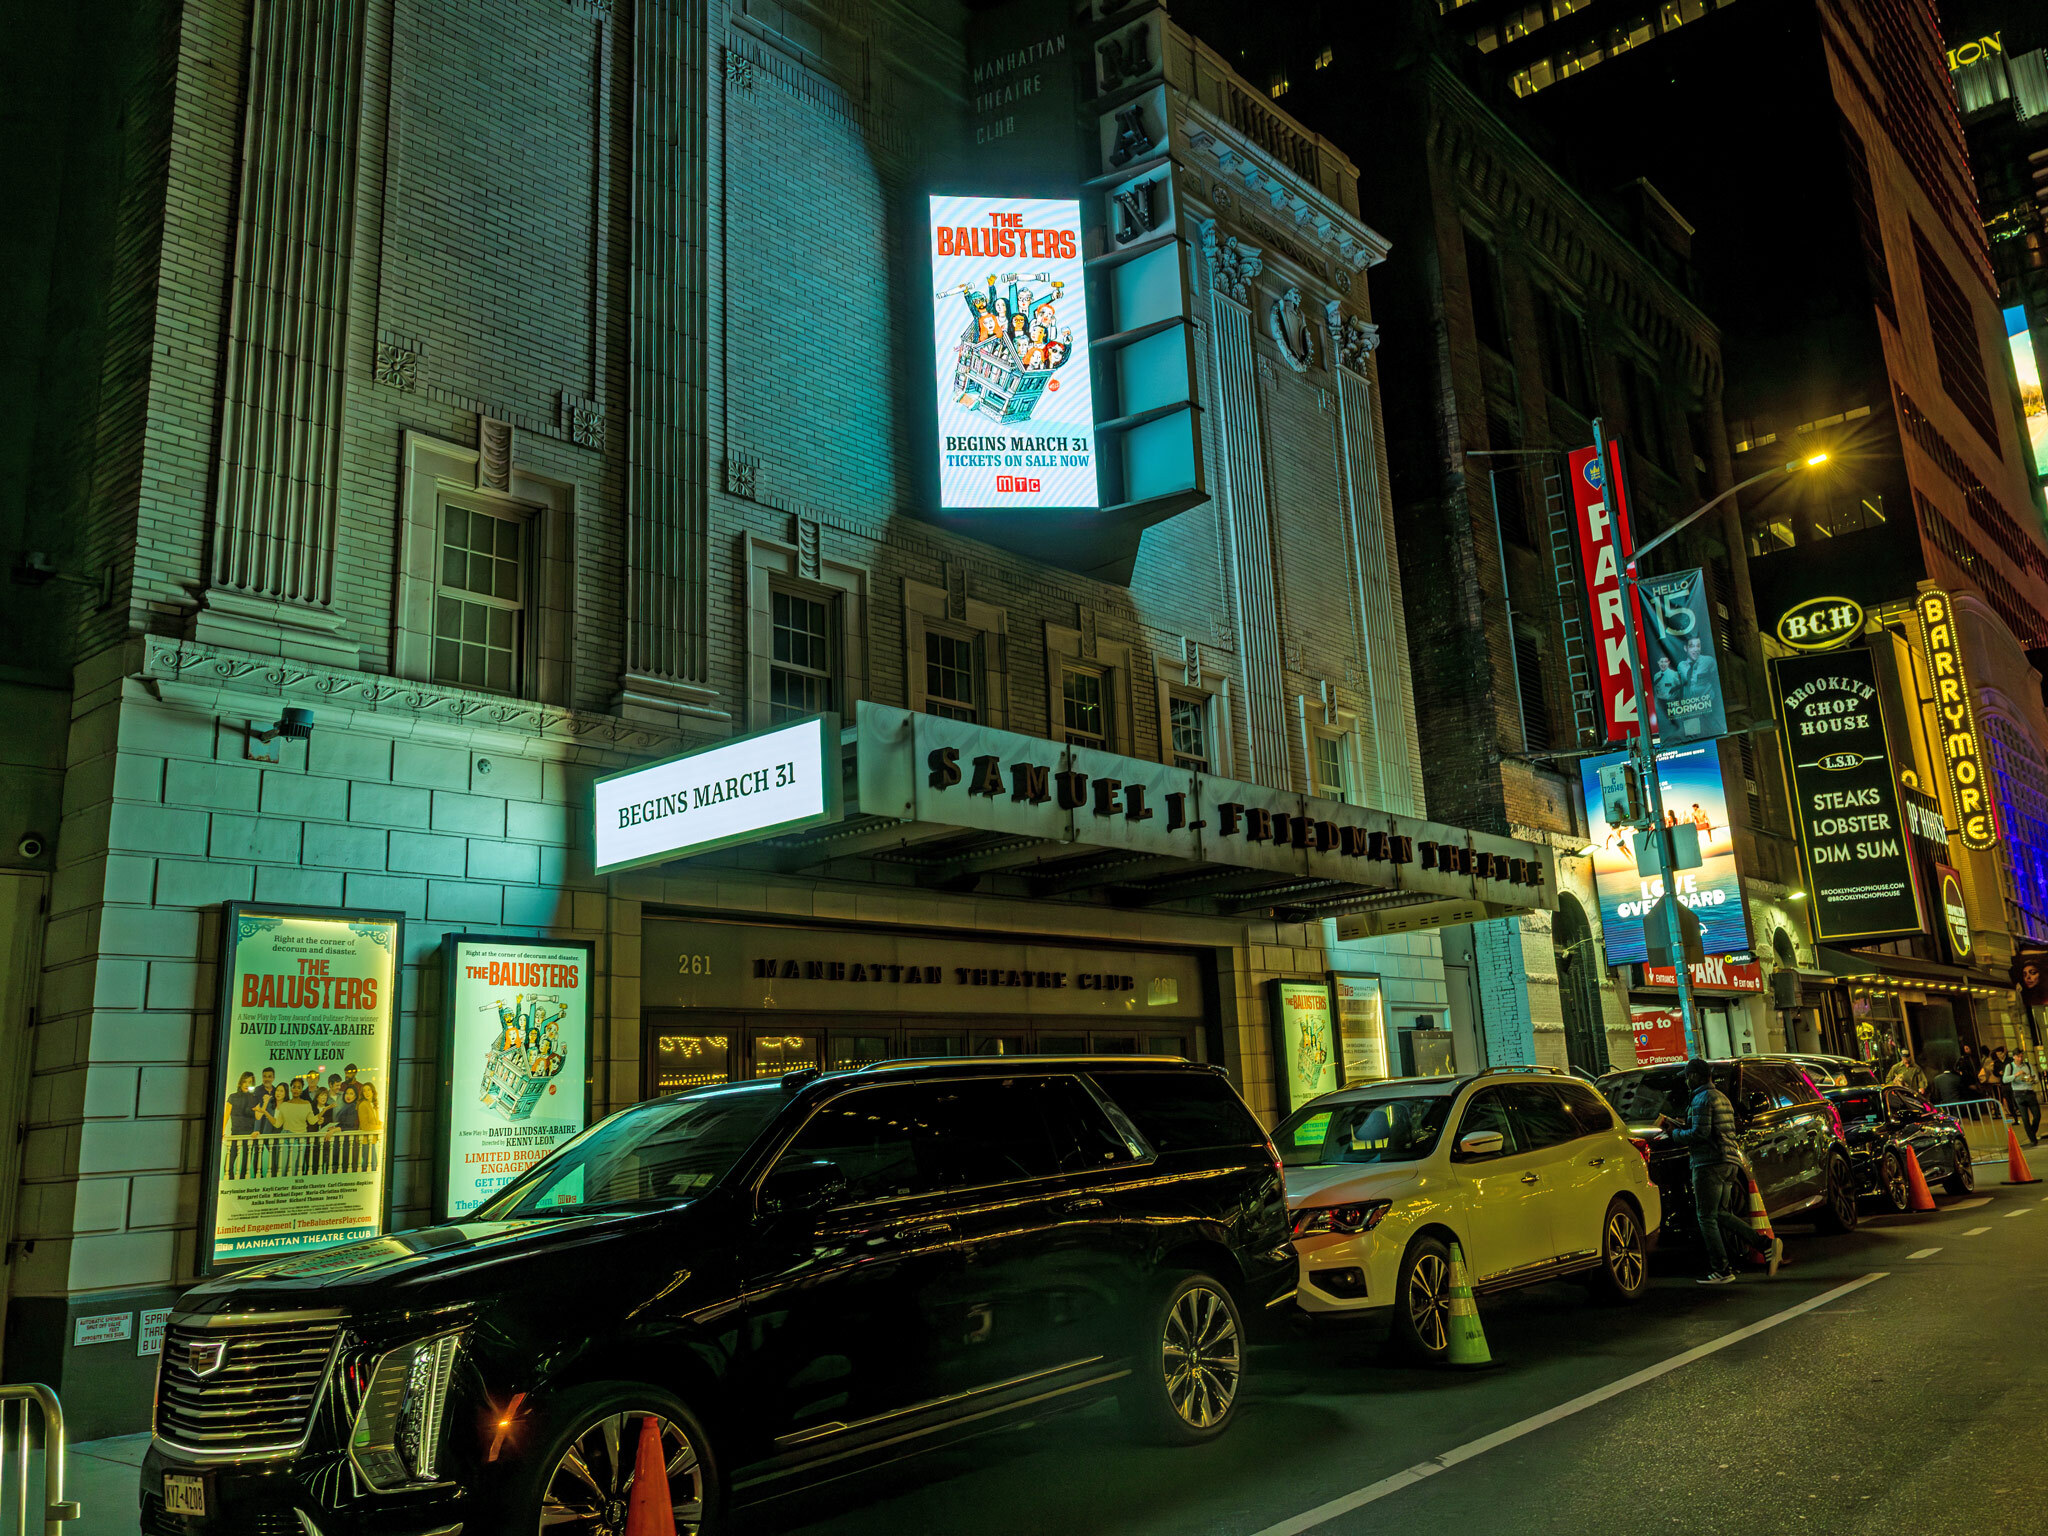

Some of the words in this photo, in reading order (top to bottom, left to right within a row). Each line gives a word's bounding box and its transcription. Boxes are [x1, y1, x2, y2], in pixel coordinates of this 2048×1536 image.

[974, 34, 1065, 84] MANHATTAN
[976, 75, 1041, 113] THEATRE
[977, 116, 1014, 144] CLUB
[989, 213, 1023, 227] THE
[937, 226, 1077, 259] BALUSTERS
[946, 436, 1006, 451] BEGINS
[1010, 437, 1068, 452] MARCH
[1072, 438, 1089, 452] 31
[946, 455, 1002, 467] TICKETS
[1004, 455, 1023, 467] ON
[1025, 455, 1057, 467] SALE
[1060, 455, 1090, 467] NOW
[996, 475, 1041, 493] MTC
[1588, 502, 1644, 676] PARK
[1652, 580, 1689, 596] HELLO
[1650, 589, 1696, 640] 15
[1786, 604, 1855, 639] BCH
[1667, 700, 1680, 708] THE
[1681, 695, 1701, 706] BOOK
[1702, 694, 1711, 702] OF
[1785, 676, 1876, 709] BROOKLYN
[1667, 700, 1712, 716] MORMON
[1804, 698, 1859, 717] CHOP
[1800, 714, 1870, 736] HOUSE
[1924, 598, 1989, 841] BARRYMORE
[1825, 754, 1858, 769] L.S.D.
[1611, 777, 1617, 785] C
[618, 791, 688, 829] BEGINS
[693, 768, 770, 809] MARCH
[775, 762, 796, 787] 31
[1813, 788, 1880, 811] STEAKS
[928, 747, 1153, 820] SAMUEL
[1165, 792, 1207, 833] J.
[1218, 802, 1413, 864] FRIEDMAN
[1418, 840, 1545, 887] THEATRE
[1813, 813, 1891, 836] LOBSTER
[1918, 807, 1949, 846] HOUSE
[1813, 843, 1851, 864] DIM
[1856, 838, 1899, 859] SUM
[1821, 882, 1905, 896] BROOKLYNCHOPHOUSE.COM
[1827, 890, 1900, 902] @BROOKLYNCHOPHOUSE
[1617, 889, 1726, 918] OVEOARD
[274, 935, 294, 944] Right
[272, 944, 307, 952] decorum
[325, 947, 357, 955] disaster.
[297, 958, 330, 976] THE
[465, 966, 489, 979] THE
[489, 961, 579, 988] BALUSTERS
[678, 954, 712, 975] 261
[753, 958, 943, 984] MANHATTAN
[955, 967, 1067, 989] THEATRE
[1078, 973, 1135, 991] CLUB
[1655, 974, 1676, 984] ENTRANCE
[1739, 980, 1747, 988] EXIT
[1747, 980, 1755, 988] ONLY
[241, 974, 378, 1010] BALUSTERS
[1293, 995, 1327, 1010] BALUSTERS
[257, 1014, 269, 1022] Play
[270, 1014, 277, 1022] by
[278, 1014, 291, 1022] Tony
[1631, 1020, 1654, 1031] me
[1656, 1017, 1671, 1028] to
[240, 1022, 276, 1035] DAVID
[280, 1023, 375, 1035] LINDSAY-ABAIRE
[269, 1048, 311, 1060] KENNY
[314, 1048, 345, 1060] LEON
[1637, 1057, 1648, 1065] our
[1649, 1055, 1683, 1064] Patronage
[489, 1128, 512, 1137] DAVID
[515, 1125, 576, 1136] LINDSAY-ABAIRE
[506, 1137, 532, 1147] KENNY
[535, 1136, 555, 1145] LEON
[465, 1151, 510, 1163] LIMITED
[475, 1178, 494, 1187] GET
[455, 1199, 486, 1210] TheBa
[217, 1224, 246, 1234] Limited
[247, 1221, 292, 1233] Engagement
[297, 1216, 371, 1228] TheBalustersPlay.com
[236, 1236, 300, 1250] MANHATTAN
[303, 1232, 344, 1244] THEATRE
[346, 1231, 371, 1240] CLUB
